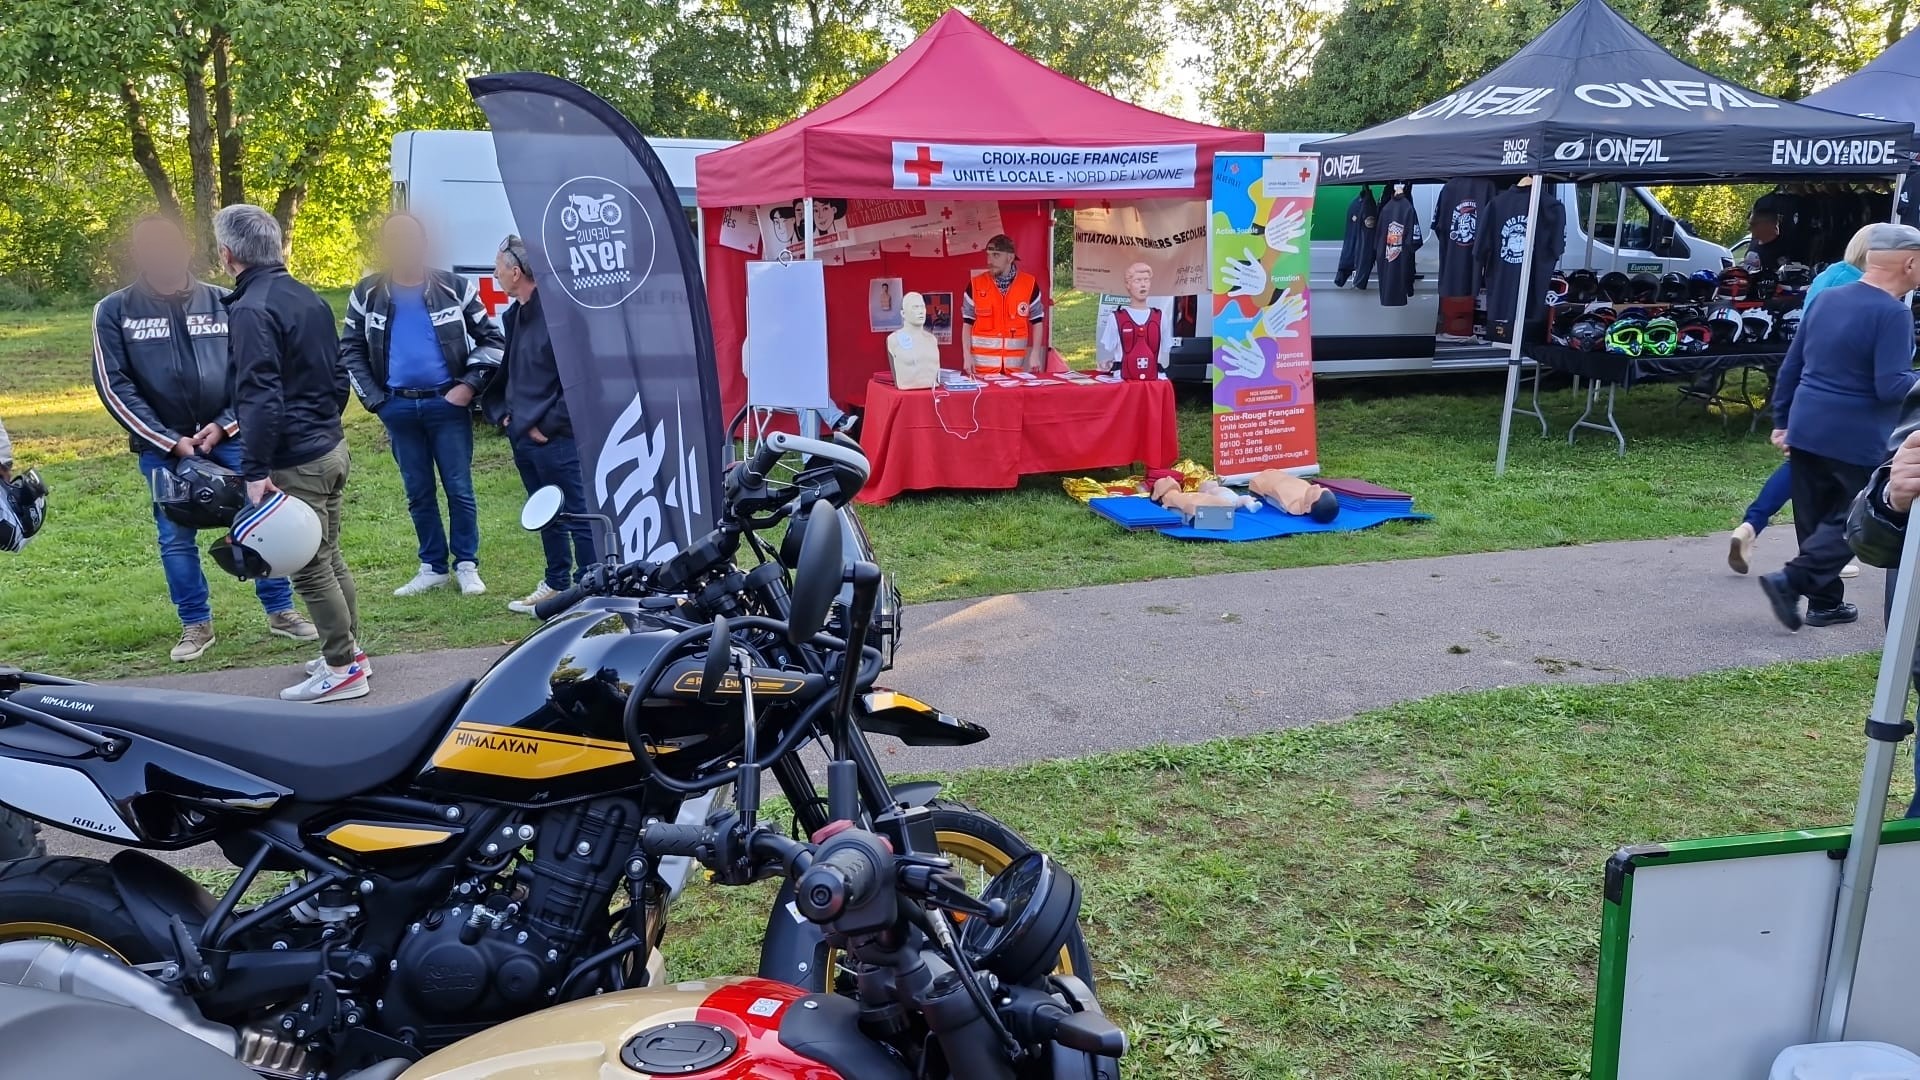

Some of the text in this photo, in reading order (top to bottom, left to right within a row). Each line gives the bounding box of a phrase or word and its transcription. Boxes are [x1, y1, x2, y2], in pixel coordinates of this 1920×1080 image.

[1503, 138, 1530, 152] ENJOY
[1772, 139, 1845, 165] ENJOY
[982, 152, 1159, 167] CROIX-ROUGE FRANÇAISE
[953, 168, 995, 182] UNITÉ
[1000, 170, 1055, 183] LOCALE
[1067, 170, 1106, 183] NORD
[1110, 170, 1127, 182] DE
[1130, 168, 1184, 181] L'YONNE
[1075, 232, 1118, 246] INITIATION
[1119, 236, 1136, 246] AUX
[1135, 237, 1173, 249] PREMIERS
[1630, 263, 1660, 273] Europcar
[1276, 352, 1304, 360] Urgences
[1276, 360, 1310, 369] Secourisme
[1220, 407, 1305, 422] Croix-Rouge Française
[1220, 422, 1236, 431] Unité
[1238, 421, 1258, 429] locale
[1268, 418, 1285, 426] Sens
[1245, 438, 1263, 446] Sens
[1234, 448, 1243, 456] 03
[1274, 443, 1282, 451] 10
[1220, 457, 1234, 466] Mail
[40, 695, 94, 712] HIMALAYAN
[455, 732, 539, 755] HIMALAYAN
[72, 816, 116, 833] RALLY
